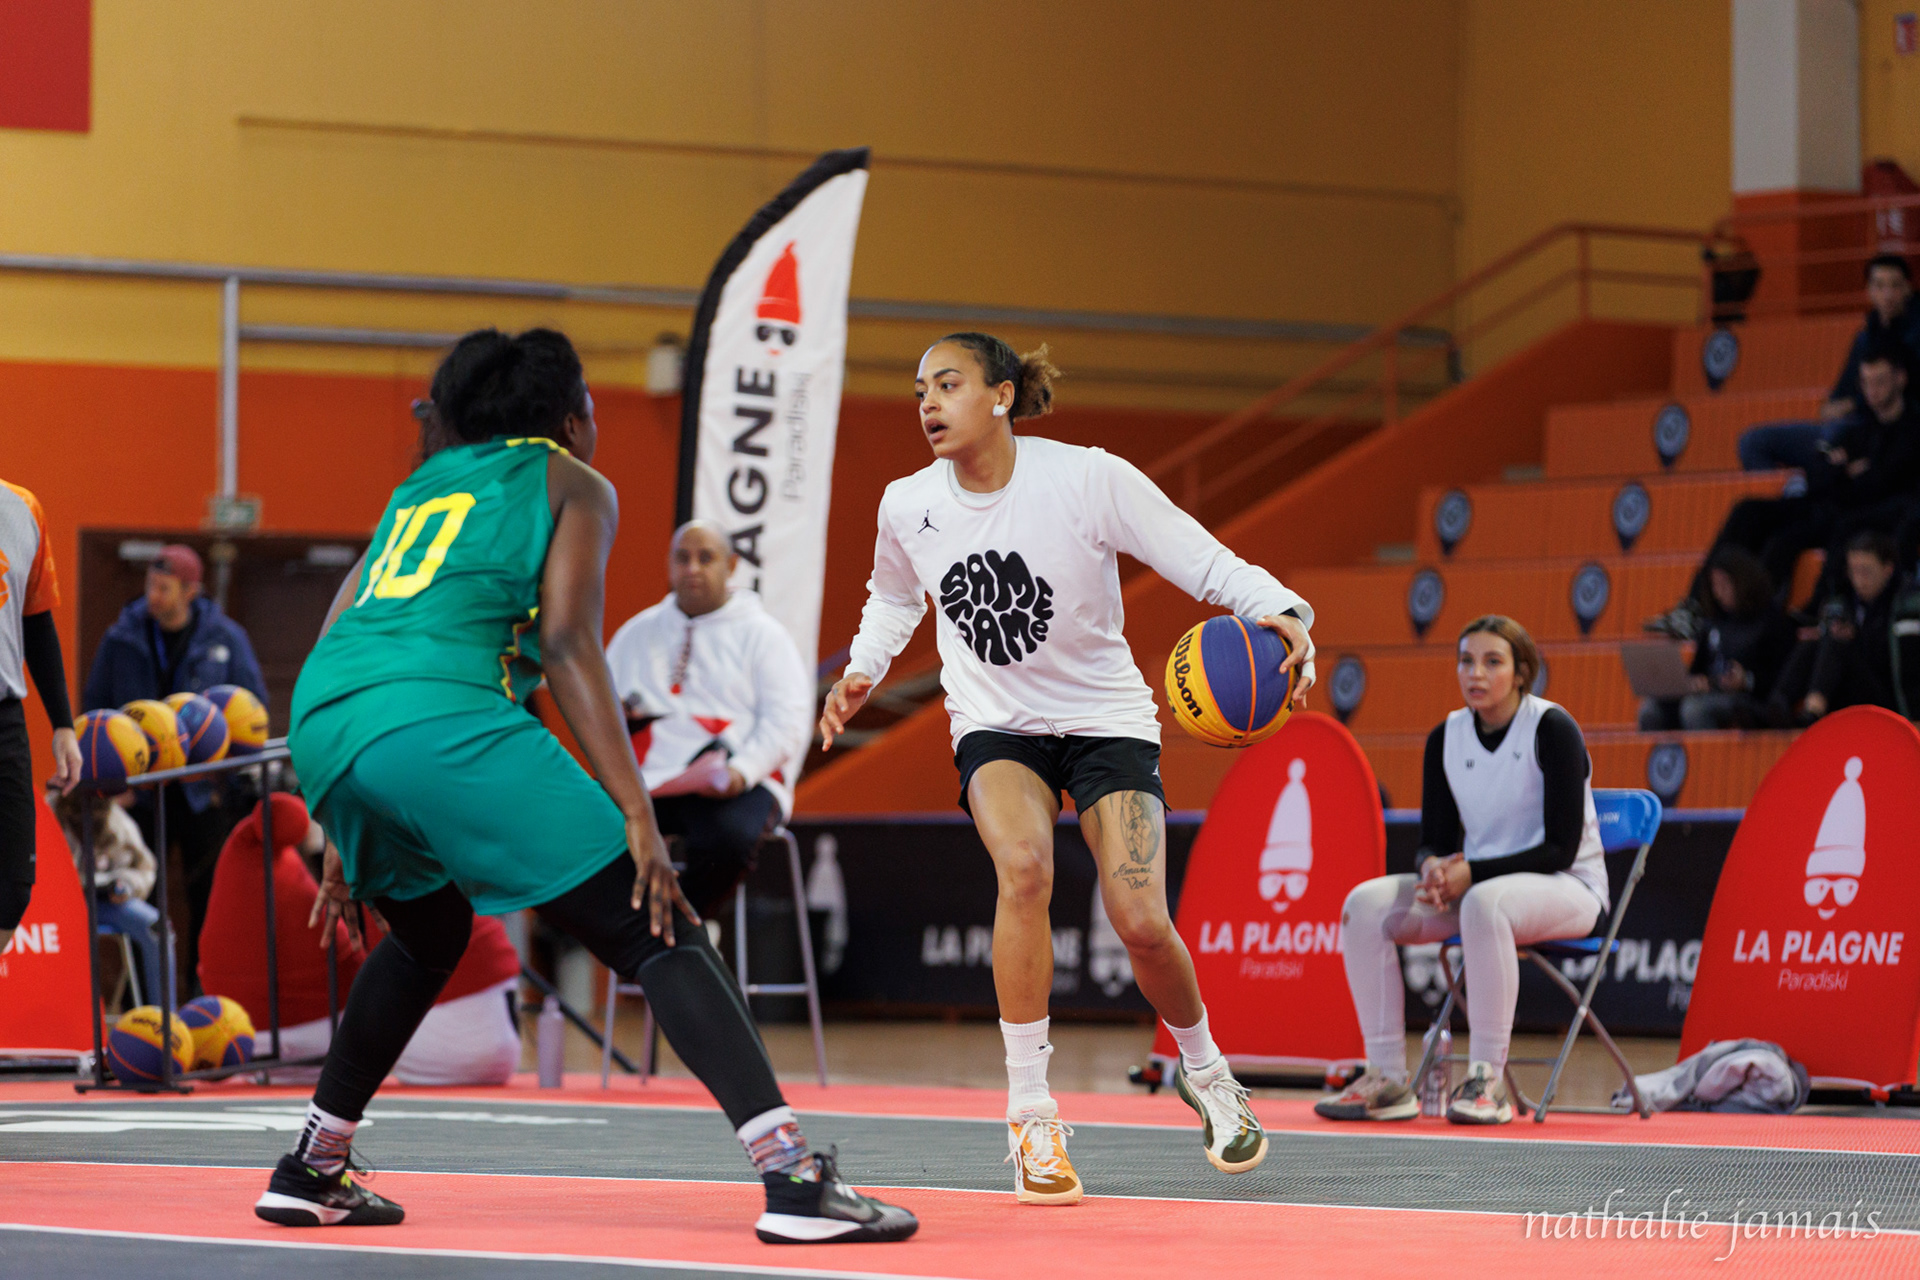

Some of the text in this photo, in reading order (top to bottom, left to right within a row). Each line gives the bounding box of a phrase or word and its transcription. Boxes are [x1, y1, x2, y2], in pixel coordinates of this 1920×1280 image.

[354, 492, 477, 608] 10
[939, 549, 1055, 621] SAME
[1173, 631, 1204, 720] Wilson
[2, 922, 61, 955] NE
[1198, 920, 1236, 954] LA
[1733, 928, 1905, 966] LA PLAGNE
[1778, 967, 1850, 992] Paradiski
